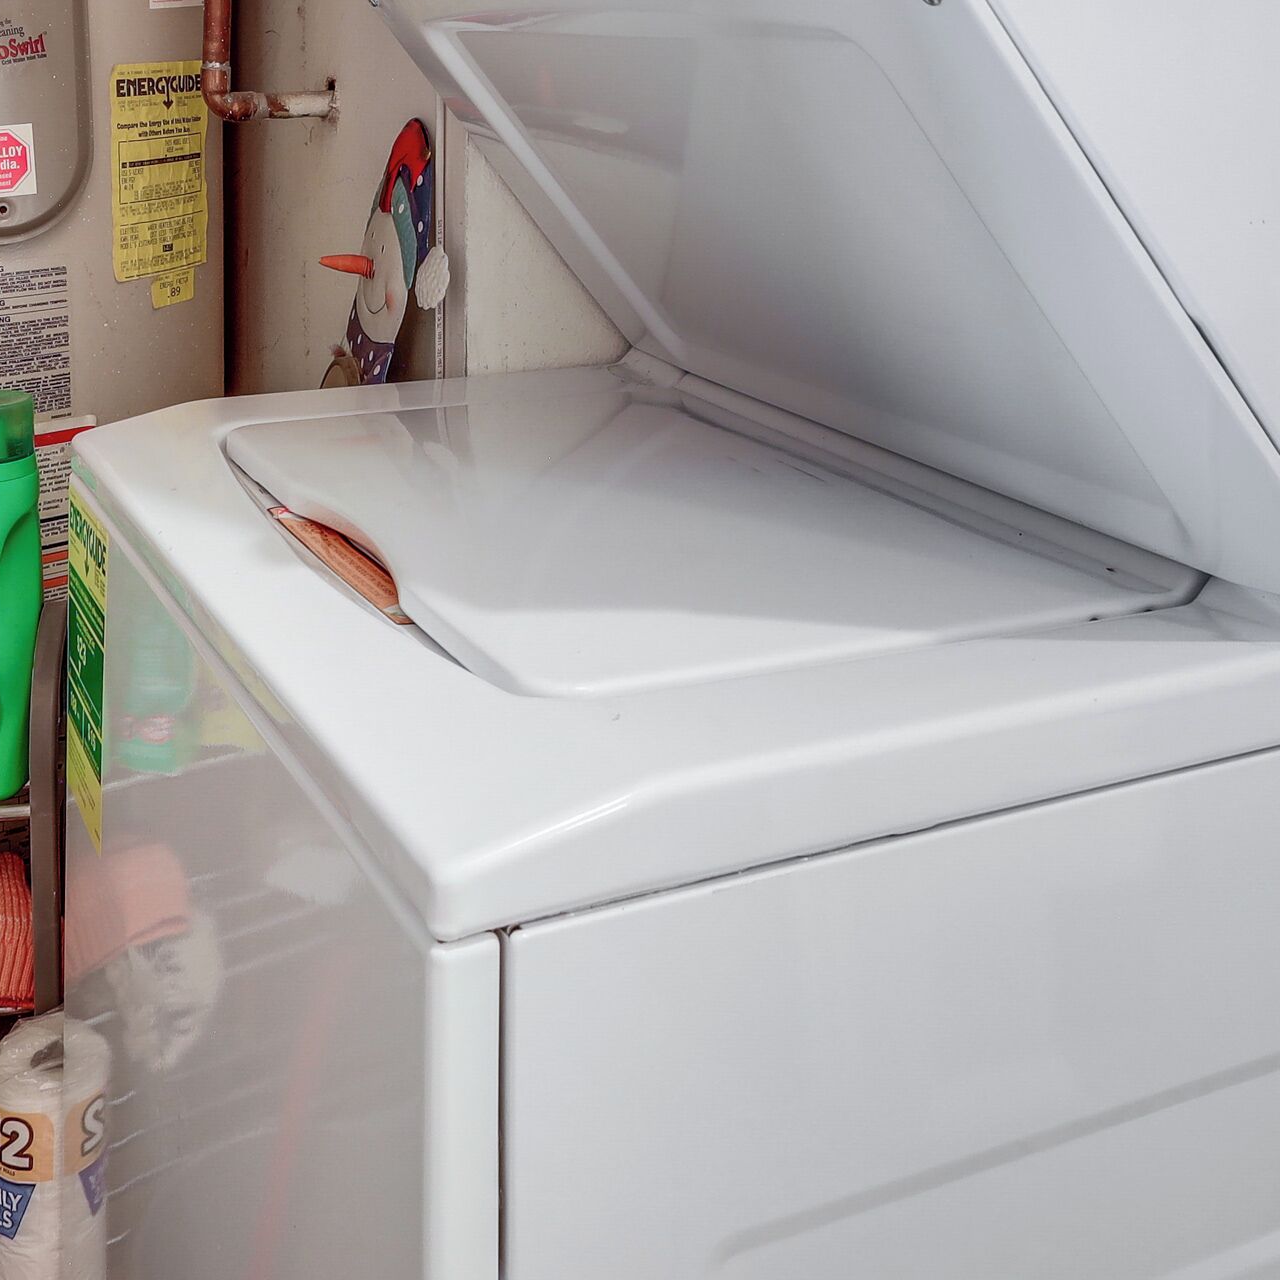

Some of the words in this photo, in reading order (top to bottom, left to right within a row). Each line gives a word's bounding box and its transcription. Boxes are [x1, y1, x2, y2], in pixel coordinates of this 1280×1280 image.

[116, 74, 201, 99] ENERGYGUIDE
[116, 122, 138, 130] Compare
[139, 121, 148, 129] the
[148, 120, 162, 128] Energy
[138, 130, 148, 138] with
[0, 158, 20, 171] dia.
[167, 286, 181, 298] .89
